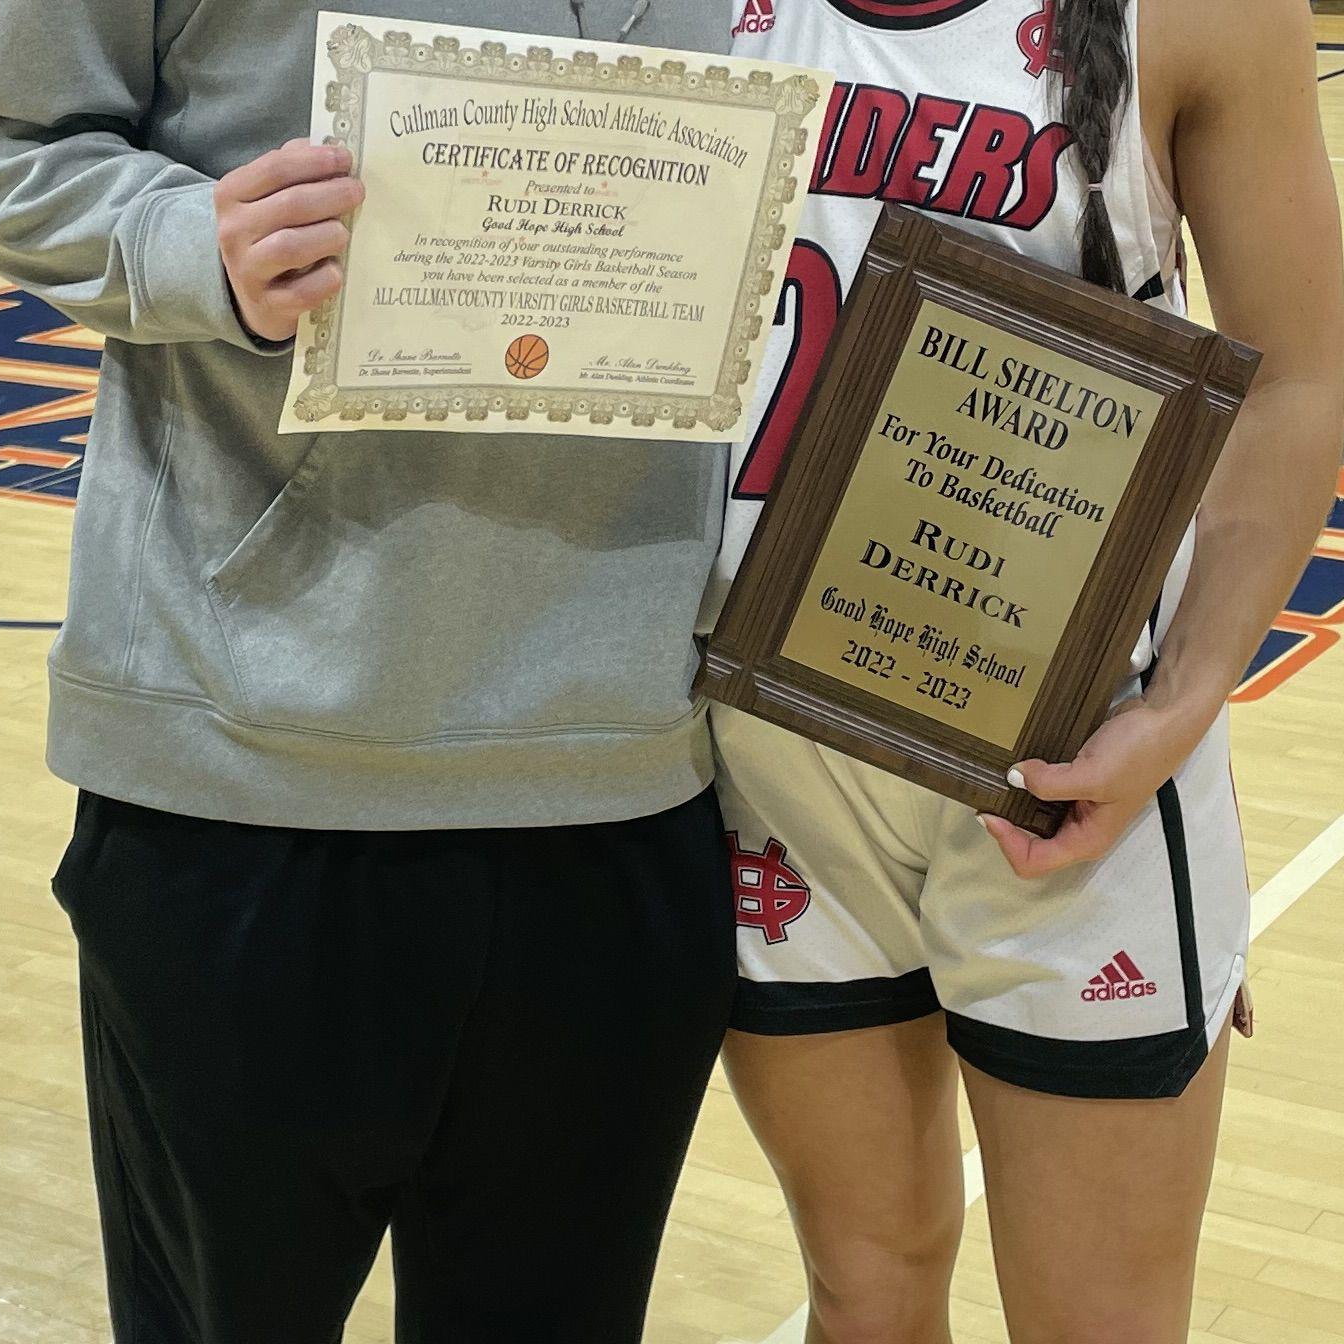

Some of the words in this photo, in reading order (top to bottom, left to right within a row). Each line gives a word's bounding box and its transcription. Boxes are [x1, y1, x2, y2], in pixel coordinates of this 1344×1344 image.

[390, 104, 458, 137] Cullman
[463, 99, 519, 131] County
[522, 98, 557, 132] High
[561, 99, 609, 128] School
[609, 104, 667, 138] Athletic
[668, 116, 749, 168] Association
[808, 81, 1079, 231] IDERS
[422, 142, 550, 172] CERTIFICATE
[554, 152, 580, 174] OF
[582, 154, 710, 186] RECOGNITION
[525, 180, 582, 195] Presented
[583, 183, 595, 196] to
[482, 217, 513, 232] Good
[516, 218, 548, 235] Hope
[551, 220, 582, 237] High
[585, 222, 625, 238] School
[487, 194, 538, 215] RUDI
[543, 197, 628, 220] DERRICK
[393, 250, 433, 265] during
[435, 251, 453, 264] the
[456, 253, 518, 267] 2022-2023
[521, 255, 561, 272] Varsity
[564, 258, 592, 272] Girls
[594, 261, 655, 277] Basketball
[656, 266, 698, 281] Season
[414, 233, 427, 246] In
[429, 236, 495, 251] recognition
[498, 237, 514, 253] of
[512, 239, 540, 254] your
[542, 242, 608, 259] outstanding
[609, 246, 684, 263] performance
[373, 287, 457, 306] ALL-CULLMAN
[458, 289, 508, 307] COUNTY
[509, 291, 559, 311] VARSITY
[560, 294, 594, 313] GIRLS
[594, 296, 669, 319] BASKETBALL
[672, 303, 705, 322] TEAM
[421, 270, 443, 283] you
[446, 269, 474, 282] have
[477, 270, 504, 284] been
[506, 273, 553, 286] selected
[555, 278, 569, 288] as
[581, 278, 627, 291] member
[629, 280, 645, 294] of
[645, 281, 663, 294] the
[500, 313, 570, 328] 2022-2023
[918, 325, 989, 379] BILL
[995, 357, 1142, 439] SHELTON
[956, 387, 1069, 450] AWARD
[878, 414, 921, 447] For
[923, 431, 979, 470] Your
[980, 455, 1104, 523] Dedication
[904, 458, 934, 488] To
[937, 473, 1063, 538] Basketball
[910, 519, 1006, 578] RUDI
[859, 539, 1029, 628] DERRICK
[820, 585, 866, 623] Good
[868, 604, 914, 644] Hope
[917, 624, 960, 667] High
[962, 644, 1026, 688] School
[840, 639, 897, 679] 2022
[916, 671, 973, 709] 2023
[1081, 979, 1157, 1003] adidas
